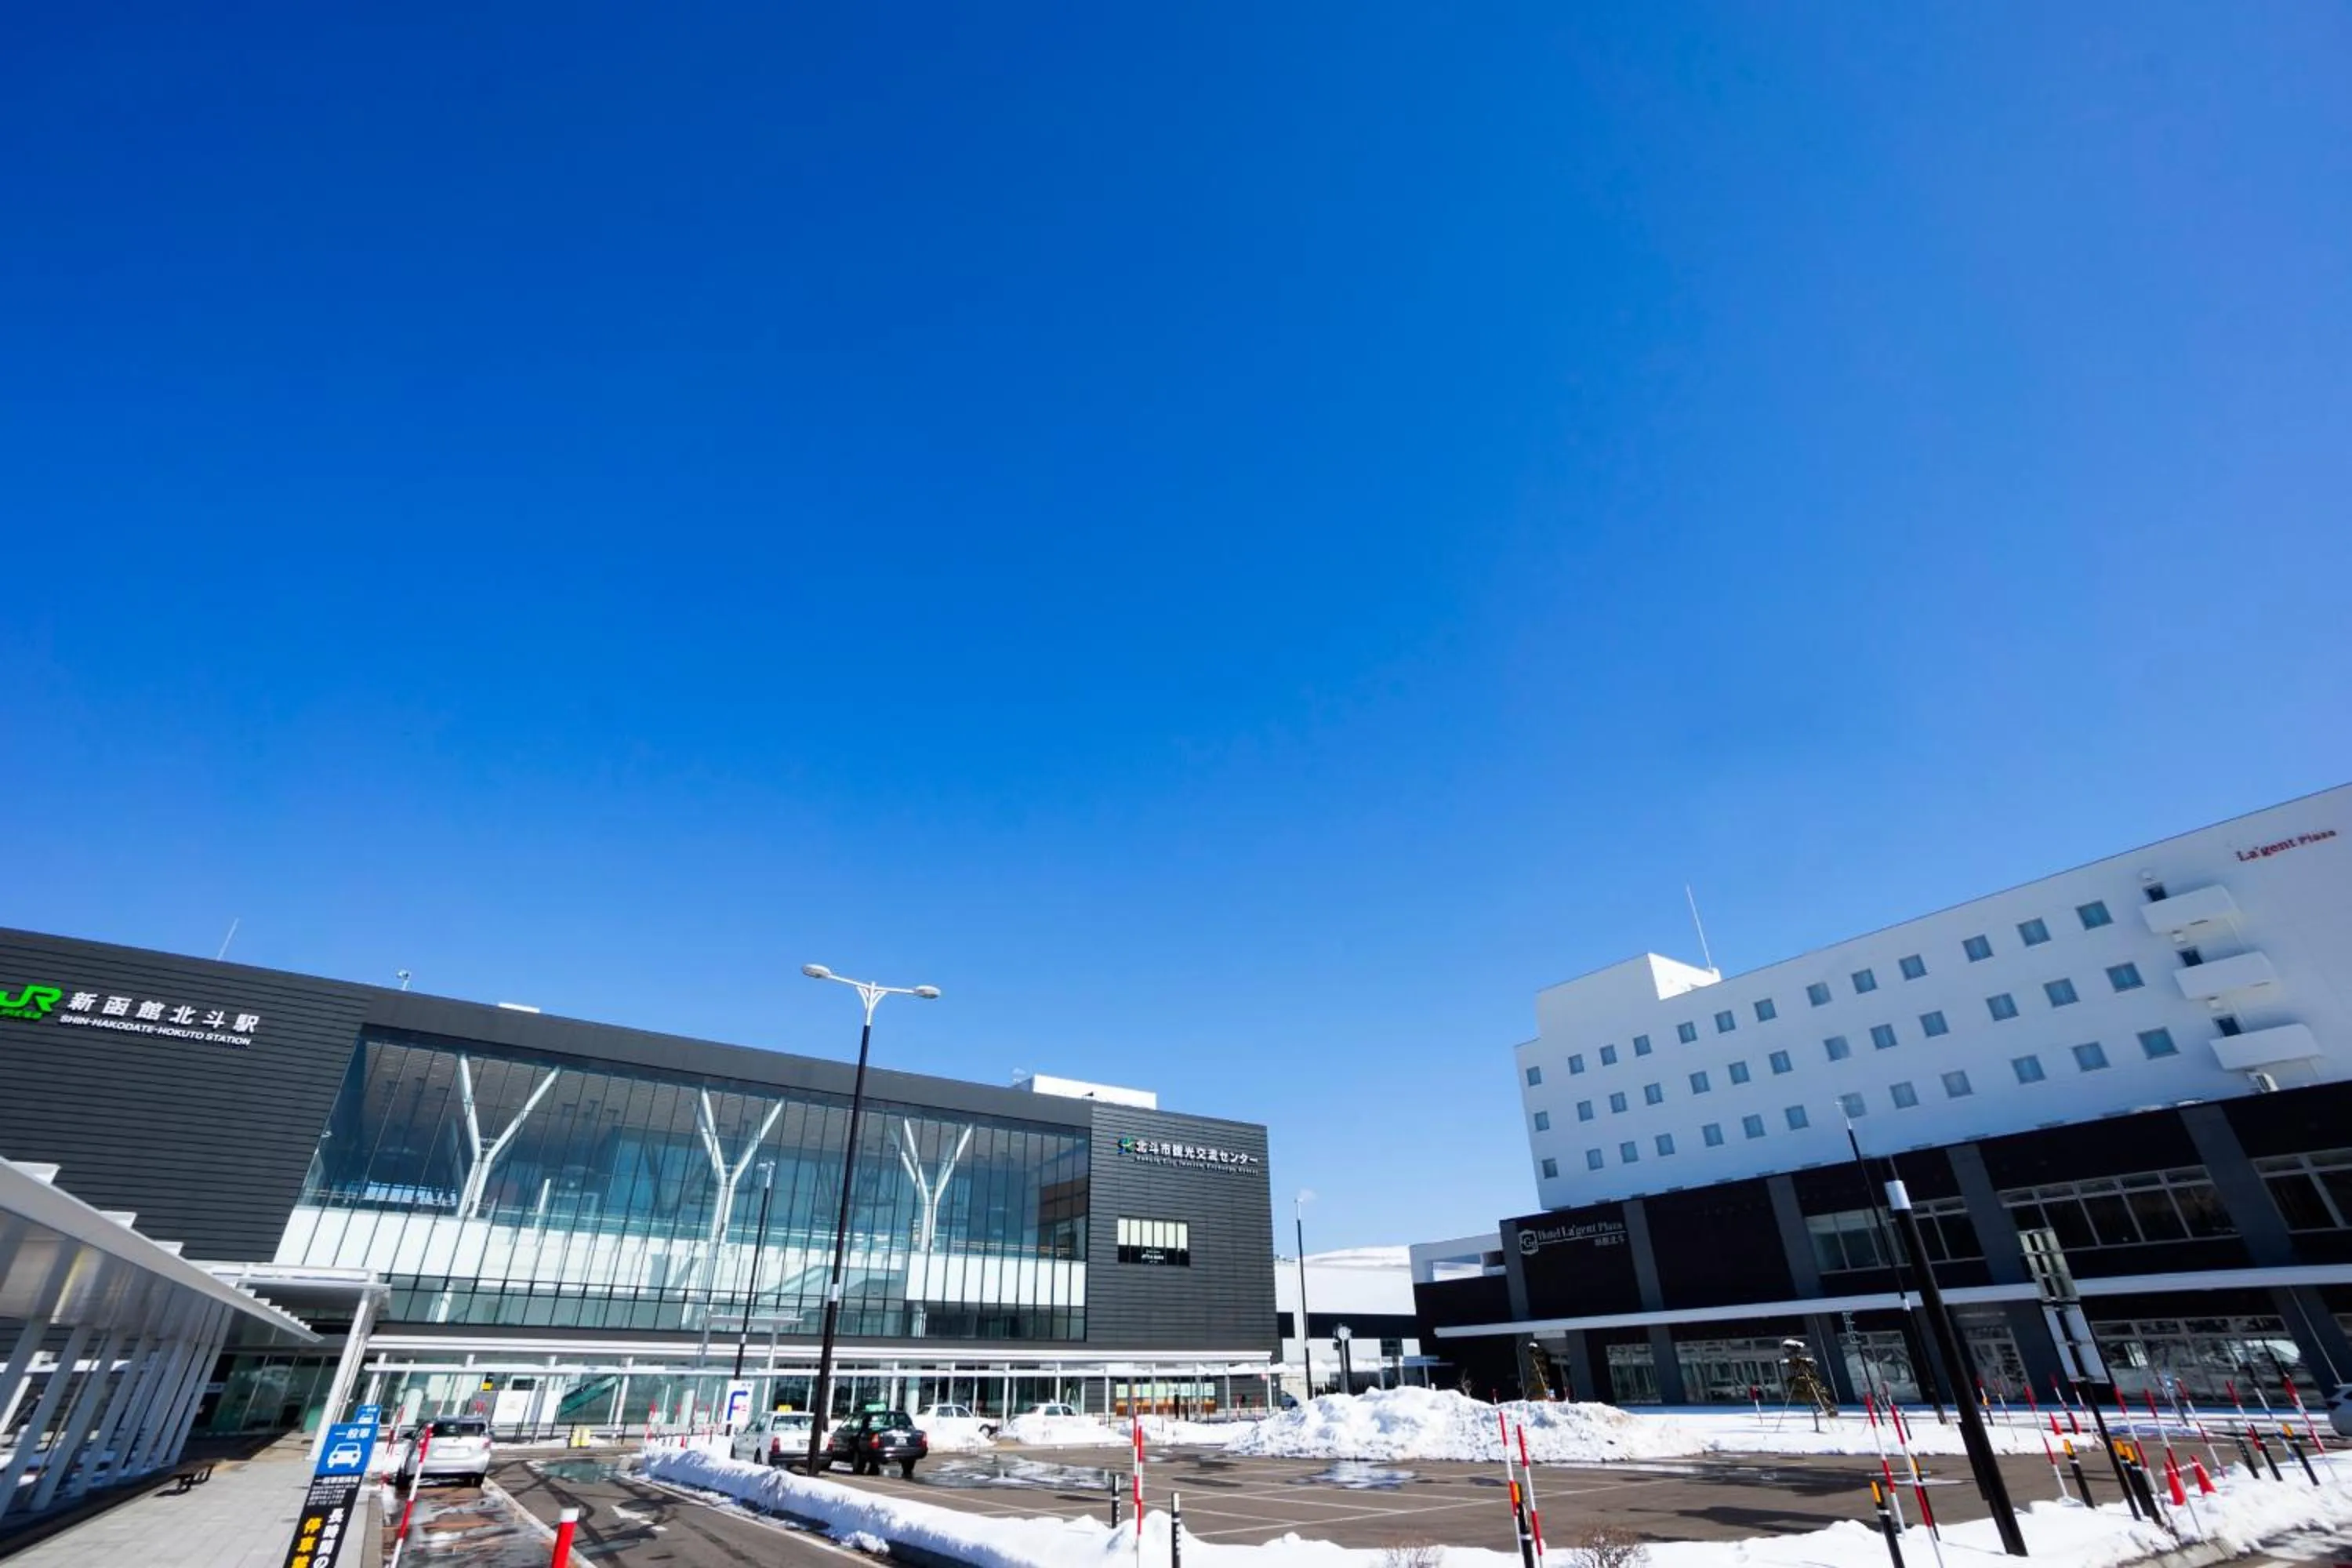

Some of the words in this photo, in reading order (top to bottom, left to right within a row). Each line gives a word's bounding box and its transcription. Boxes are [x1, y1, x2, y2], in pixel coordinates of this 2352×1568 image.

[0, 985, 63, 1012] JR
[67, 991, 260, 1033] 新函館北斗駅
[60, 1014, 204, 1040] SHIN-HAKODATE-HOKUTO
[205, 1033, 252, 1046] STATION
[1136, 1139, 1258, 1164] 北斗市観光交流センター
